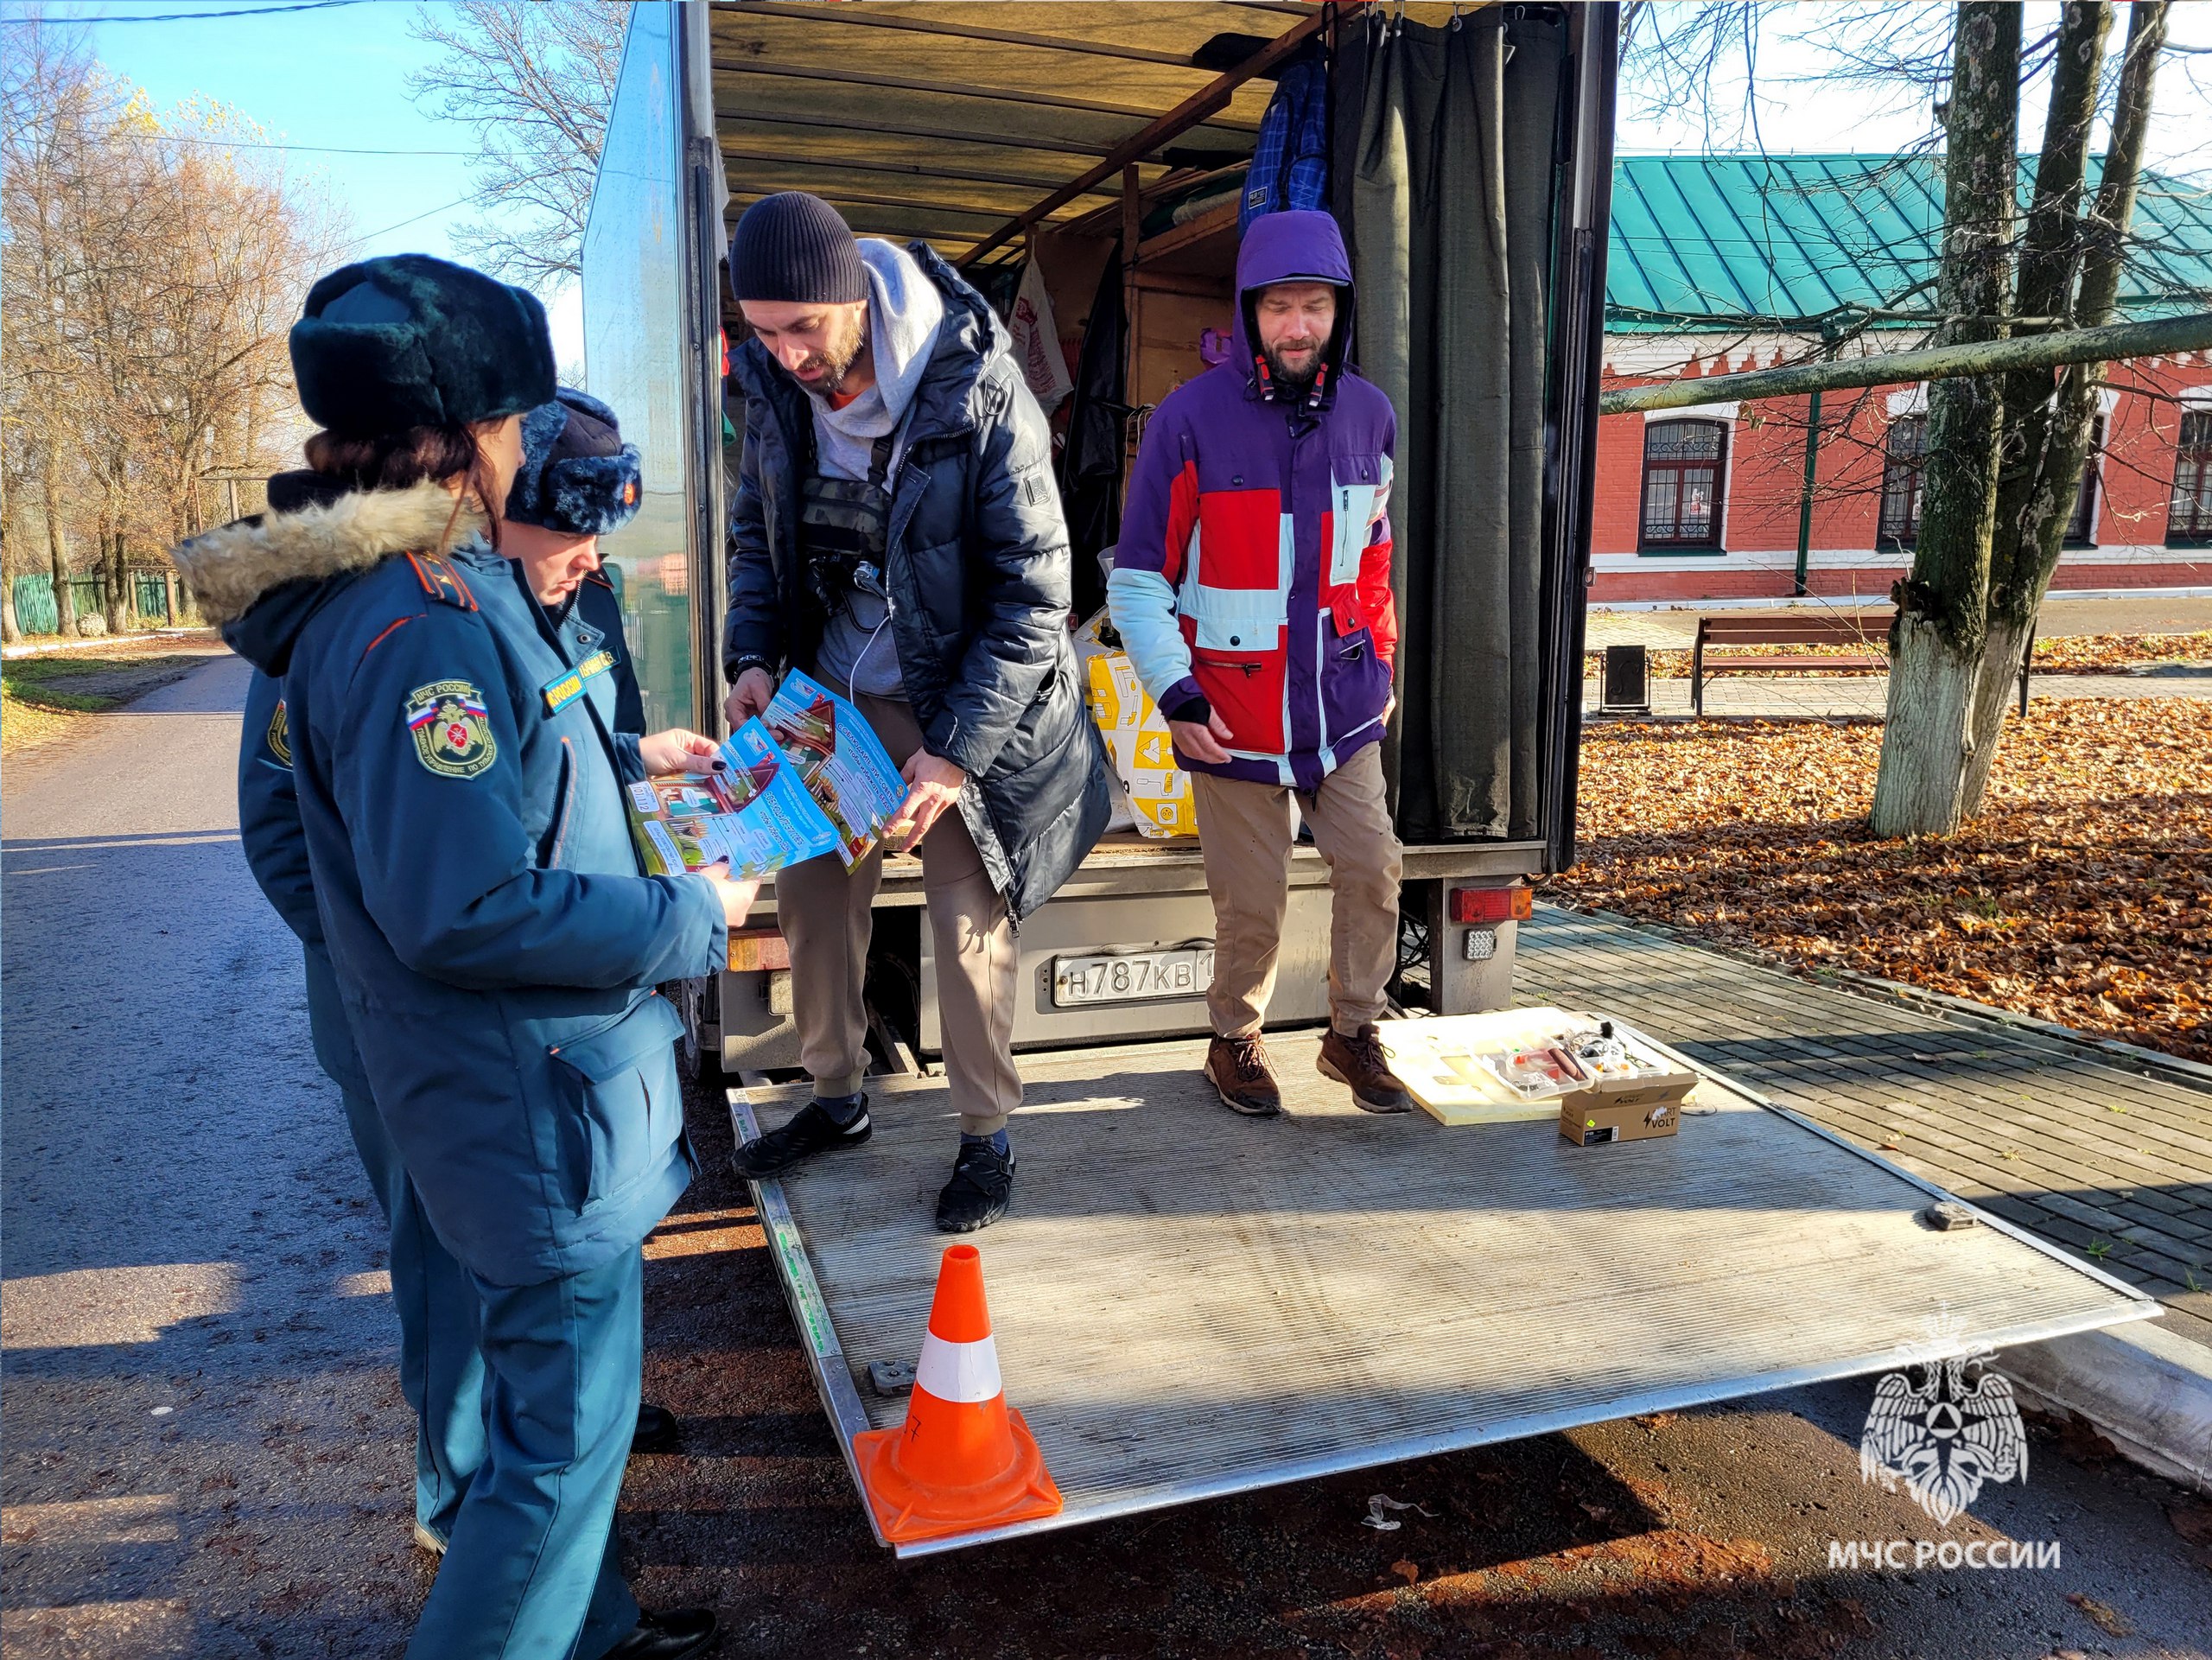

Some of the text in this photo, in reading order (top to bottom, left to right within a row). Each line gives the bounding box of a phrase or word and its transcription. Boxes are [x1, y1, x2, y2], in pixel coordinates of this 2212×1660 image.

[416, 684, 471, 702] МЧС РОССИИ
[416, 728, 429, 756] ГЛАВНОЕ
[424, 754, 465, 773] УПРАВЛЕНИЕ
[467, 764, 479, 773] ПО
[836, 723, 872, 769] СОБЛЮДАЙТЕ
[869, 766, 880, 779] ЭТИ
[848, 747, 861, 766] чтобы
[860, 764, 880, 795] избежать
[1068, 959, 1192, 996] Н787КВ
[1651, 1117, 1675, 1129] VOLT
